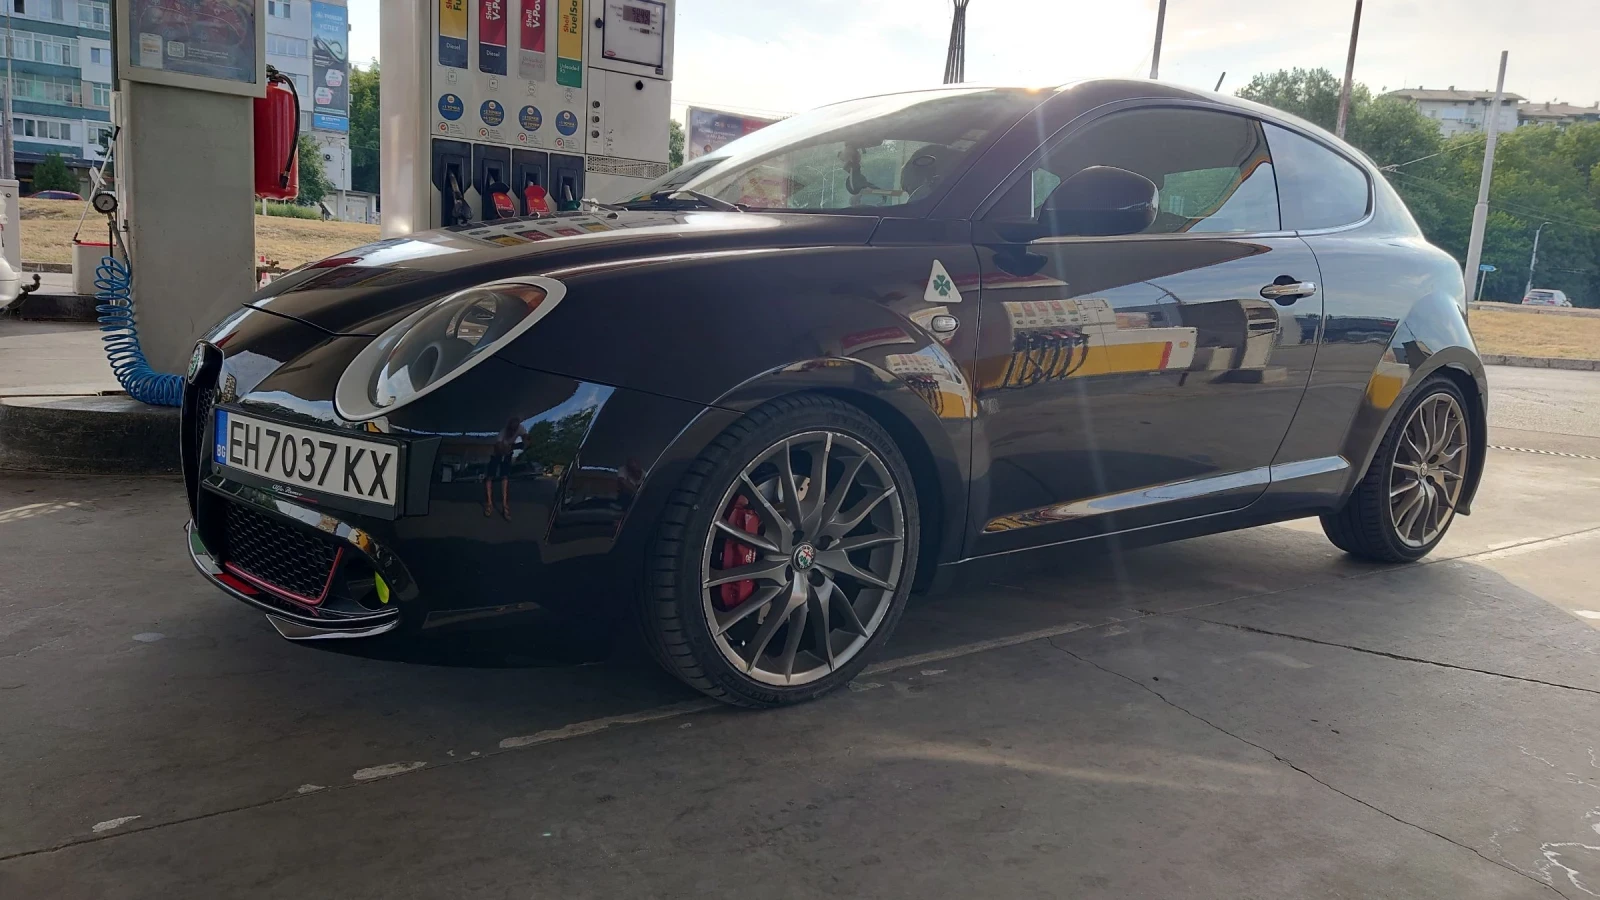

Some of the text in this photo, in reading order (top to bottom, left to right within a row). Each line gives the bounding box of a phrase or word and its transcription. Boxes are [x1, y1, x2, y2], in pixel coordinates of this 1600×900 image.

[446, 42, 460, 50] Diesel
[559, 62, 580, 72] Unleaded
[216, 444, 226, 458] BG
[272, 484, 303, 496] Alfa Romeo
